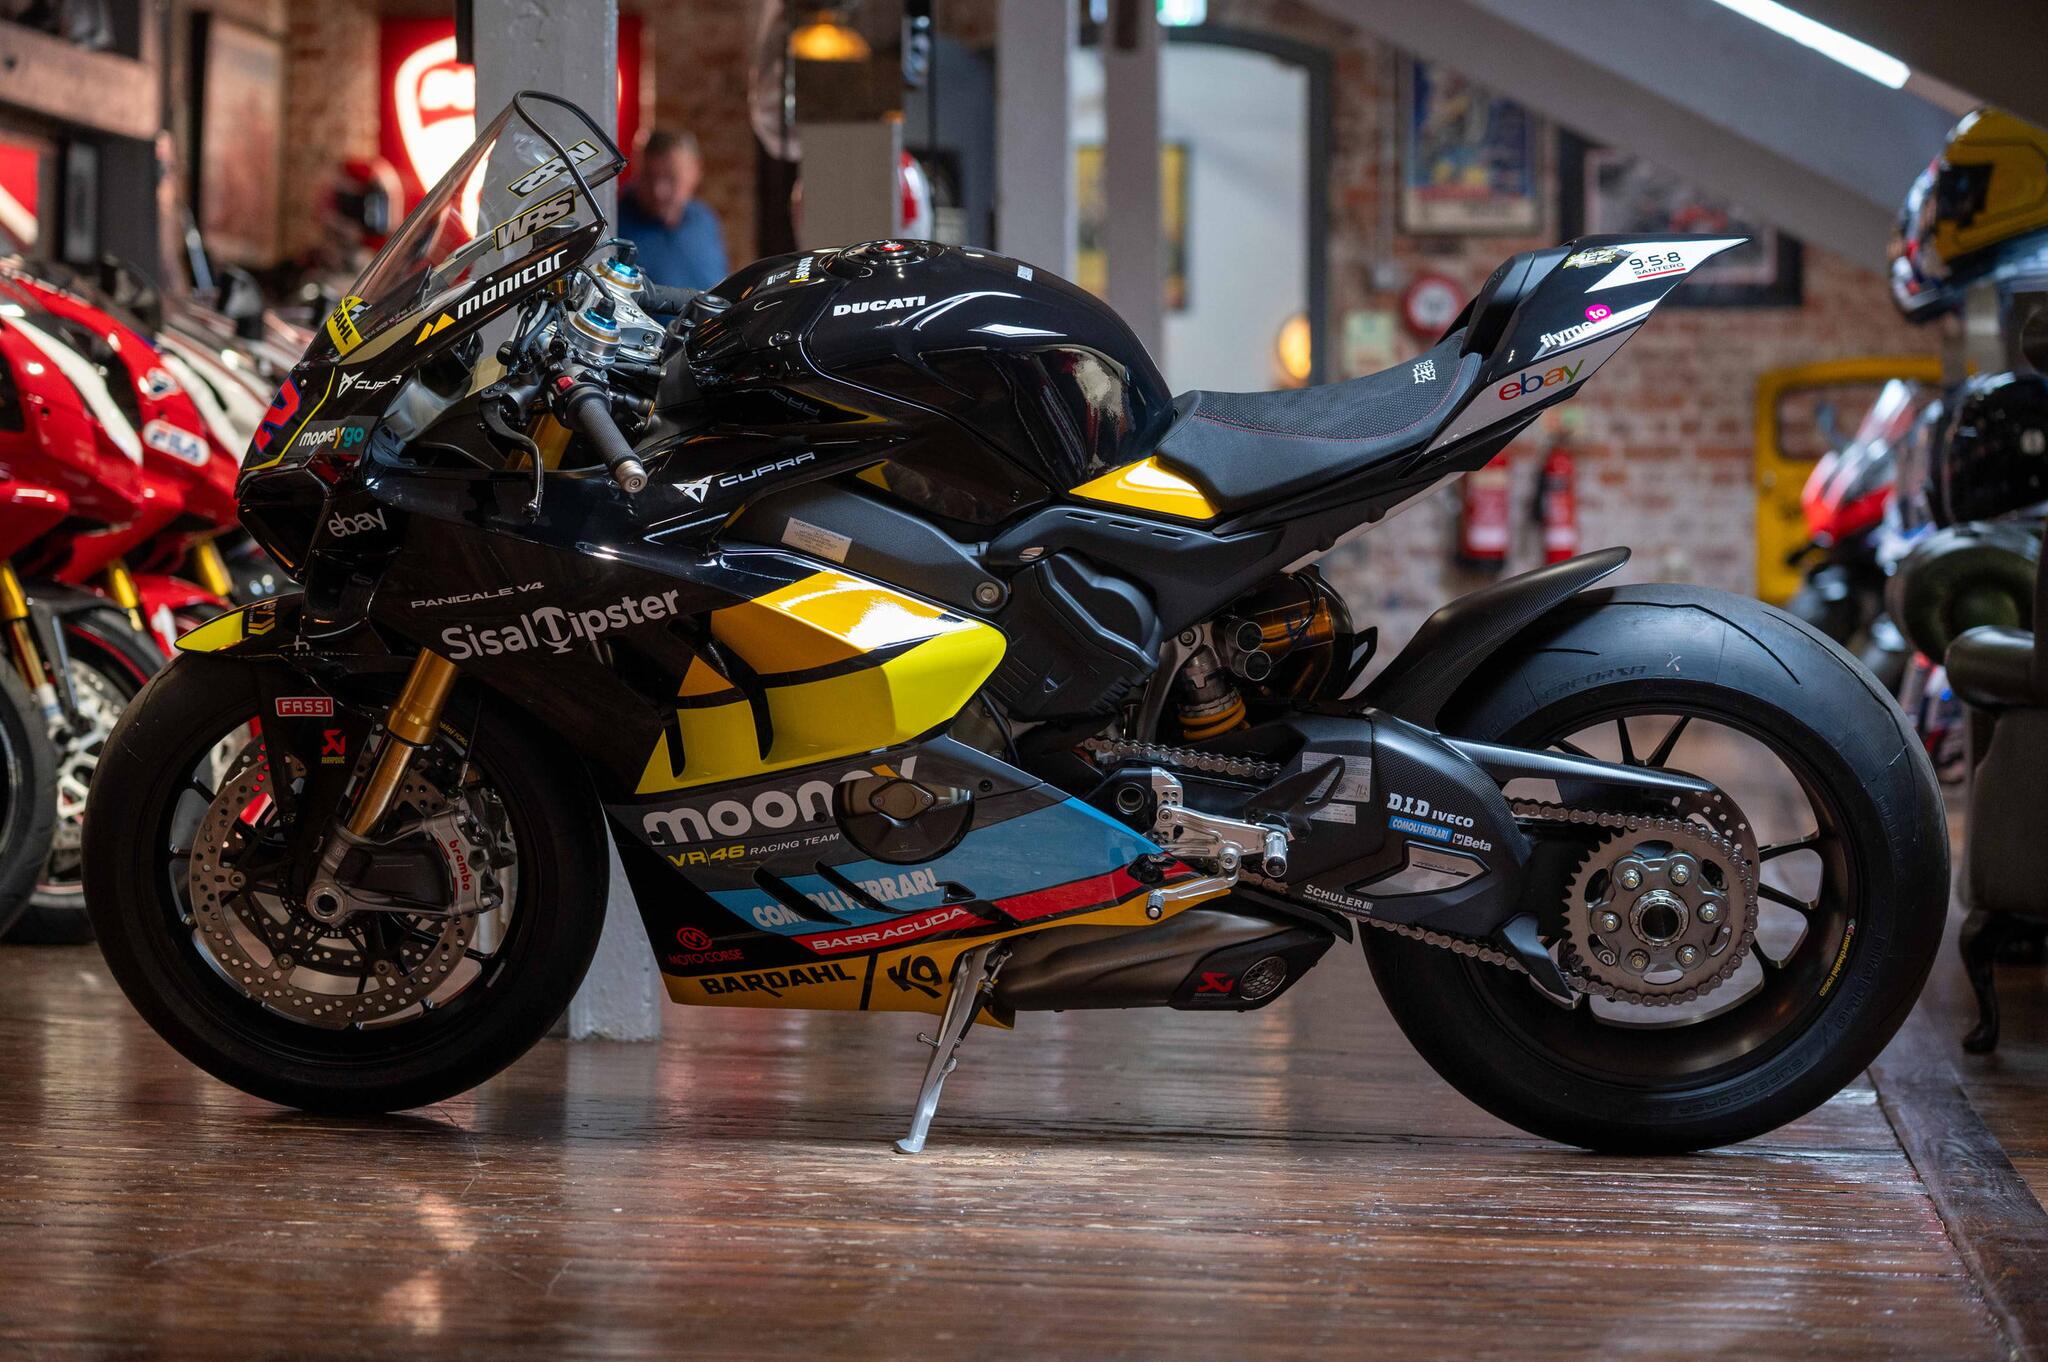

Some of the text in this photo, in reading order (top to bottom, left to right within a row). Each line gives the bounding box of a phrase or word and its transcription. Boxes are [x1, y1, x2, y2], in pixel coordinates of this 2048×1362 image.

[496, 192, 573, 249] WRS
[1634, 262, 1684, 276] SANTERO
[457, 249, 567, 319] monitor
[833, 295, 926, 316] DUCATI
[1499, 359, 1585, 401] ebay
[719, 452, 815, 487] CUPRA
[328, 508, 387, 537] ebay
[411, 581, 544, 608] PANIGALE V4
[281, 701, 329, 713] FASSI
[1392, 819, 1449, 840] COMOLI FERRARI
[1432, 810, 1474, 828] IVECO
[750, 839, 801, 855] RACING
[804, 833, 840, 846] TEAM
[1463, 835, 1492, 852] Beta
[449, 839, 473, 891] brembo
[1305, 884, 1363, 908] SCHULER
[812, 907, 968, 950] BARRACUDA
[704, 949, 744, 962] CORSE
[700, 963, 856, 999] BARDAHL
